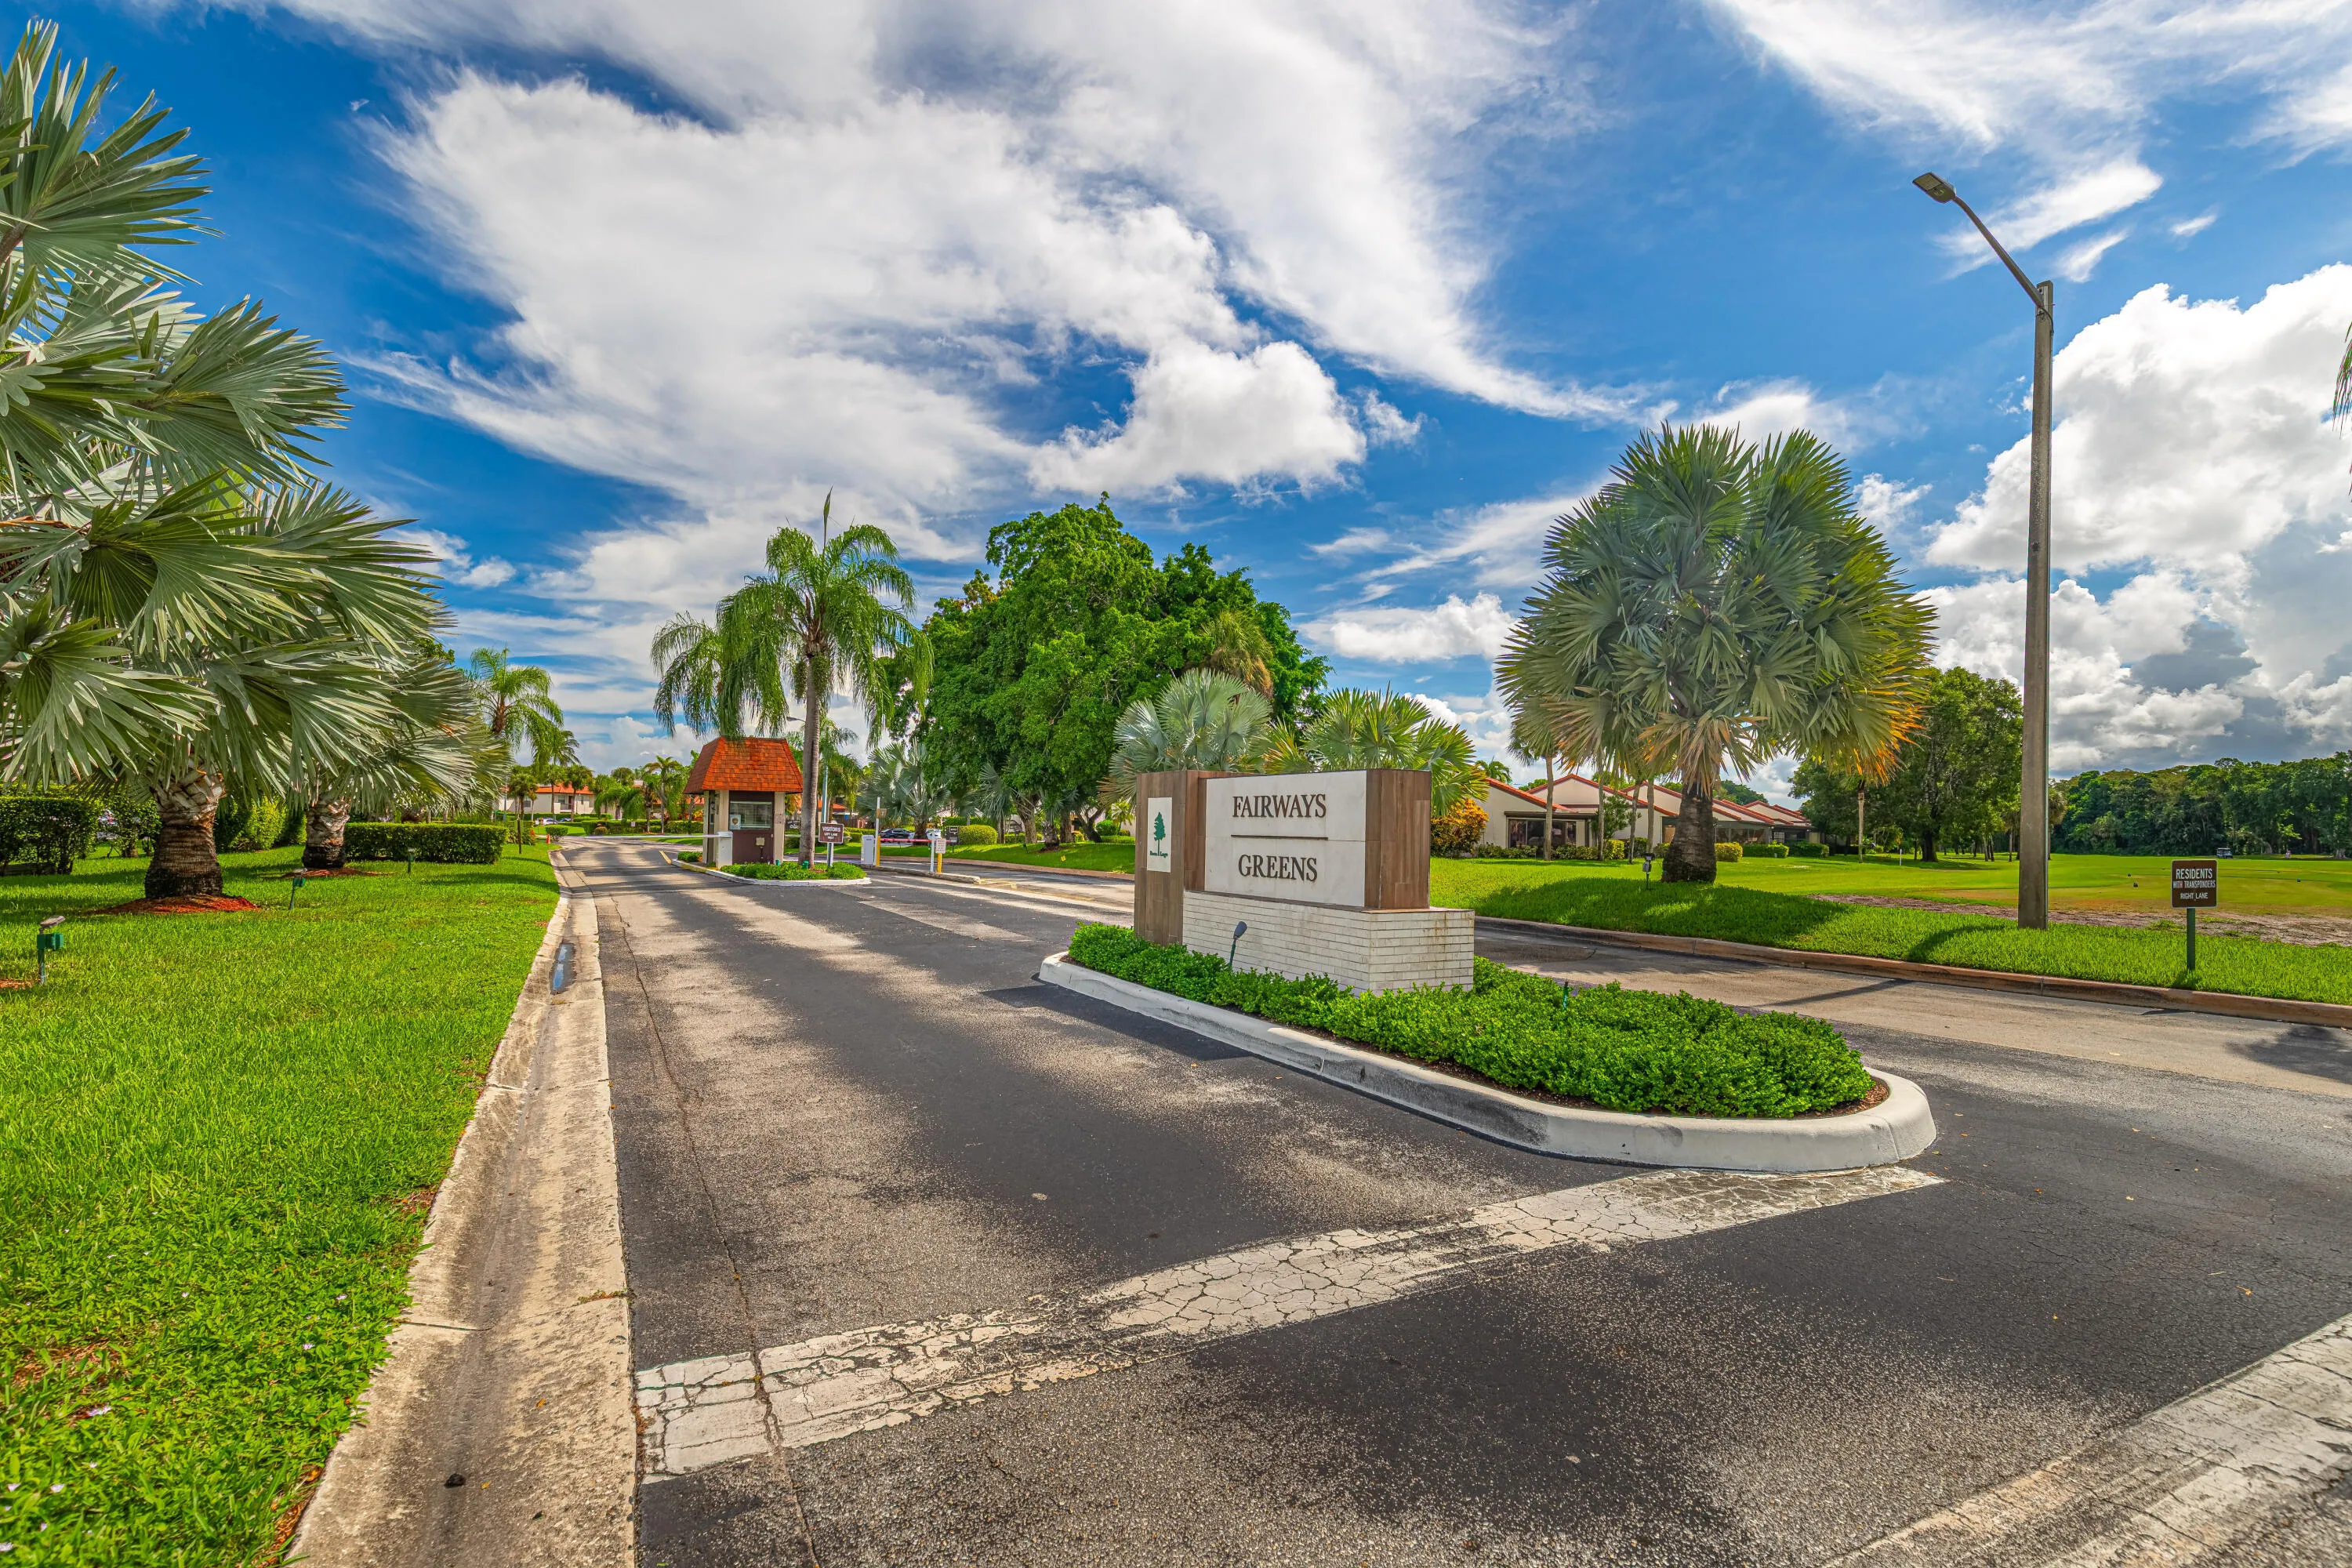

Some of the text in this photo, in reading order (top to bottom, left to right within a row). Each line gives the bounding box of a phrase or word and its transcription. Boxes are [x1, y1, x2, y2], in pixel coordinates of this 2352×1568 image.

[1232, 793, 1327, 818] FAIRWAYS
[1238, 854, 1318, 882] GREENS
[2176, 868, 2212, 879] RESIDENTS
[2184, 880, 2216, 888] TRANSPONDERS
